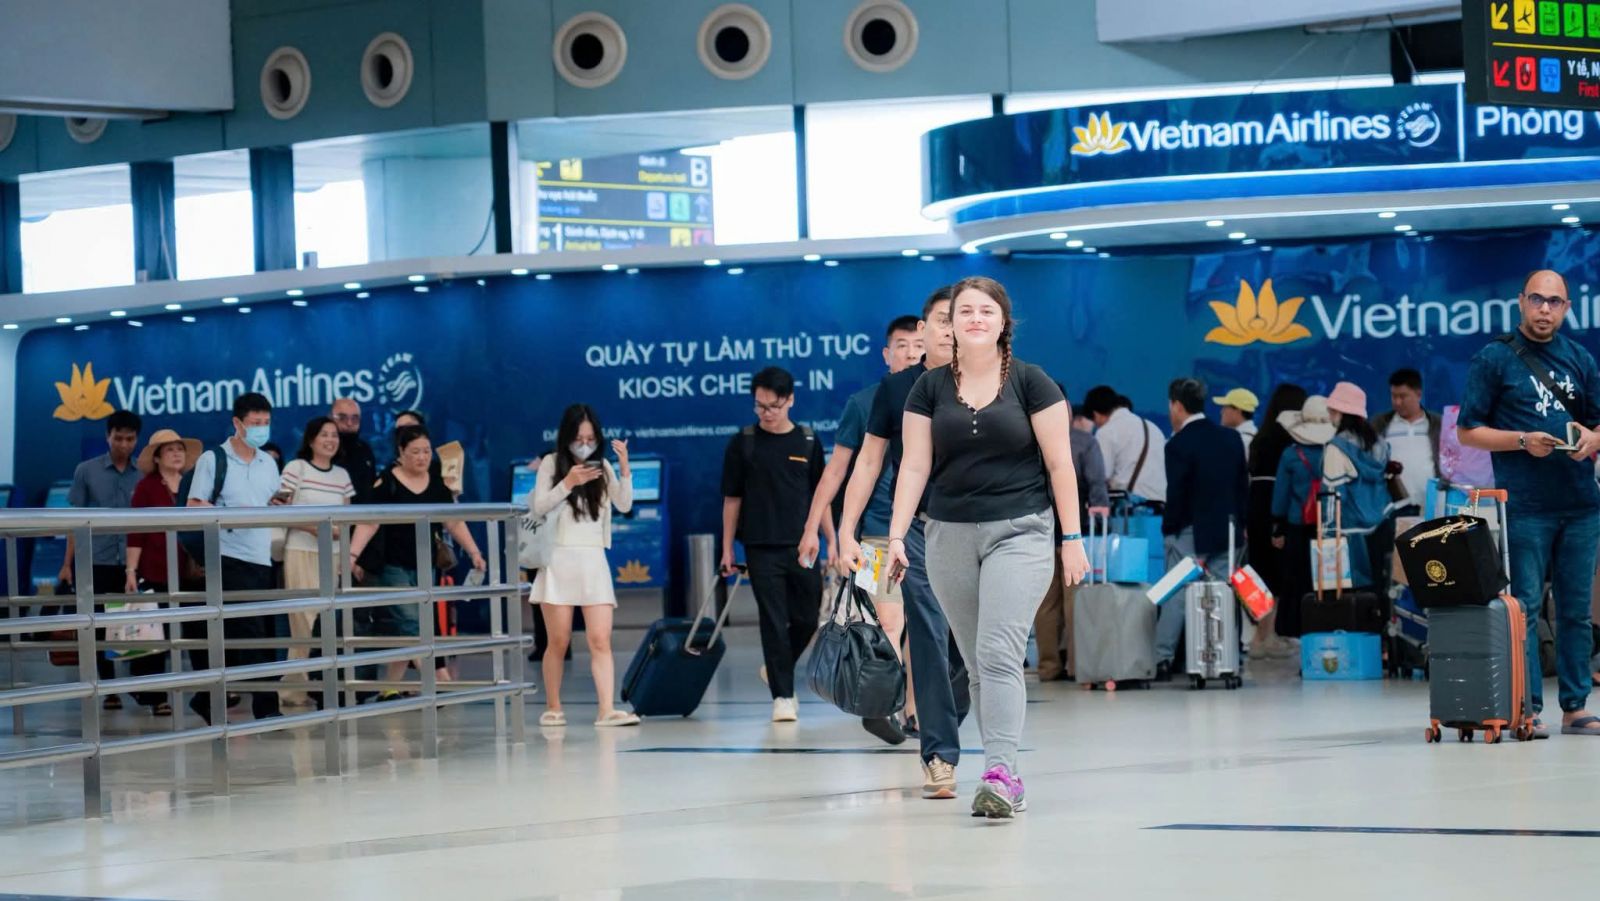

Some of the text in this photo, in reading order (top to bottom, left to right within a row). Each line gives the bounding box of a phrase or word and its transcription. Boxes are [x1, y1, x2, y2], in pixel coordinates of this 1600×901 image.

[1567, 60, 1576, 75] Y
[1128, 110, 1391, 152] Vietnam Airlines
[690, 157, 708, 187] B
[1311, 294, 1520, 340] Vietnam
[585, 331, 871, 368] QUÀY TỰ LÀM THỦ TỤC
[113, 363, 374, 415] Vietnam Airlines
[619, 375, 695, 399] KIOSK
[700, 373, 752, 396] CHE
[809, 368, 833, 391] IN
[1529, 370, 1576, 400] Wrk
